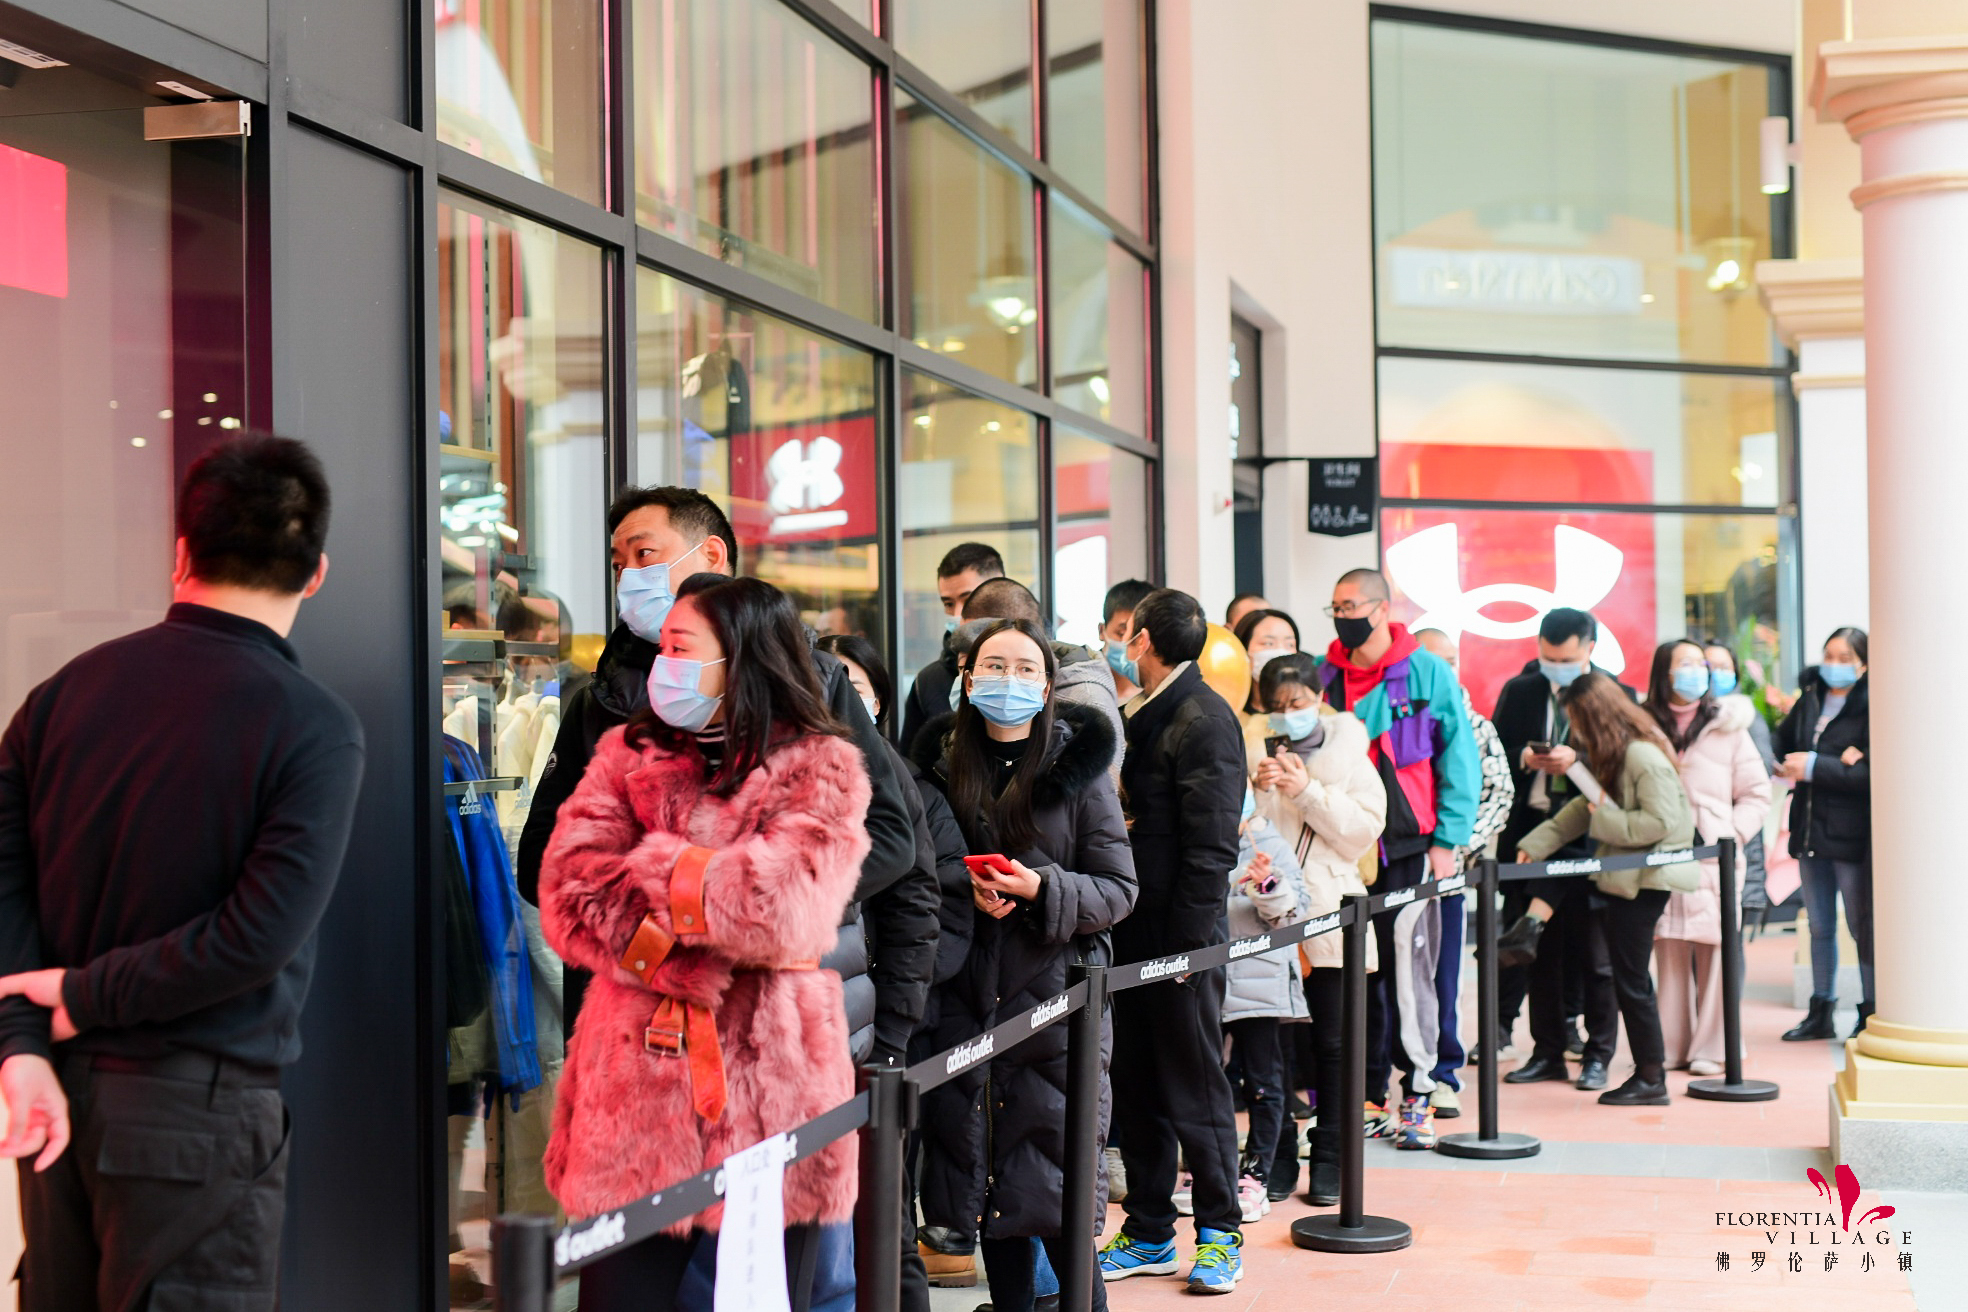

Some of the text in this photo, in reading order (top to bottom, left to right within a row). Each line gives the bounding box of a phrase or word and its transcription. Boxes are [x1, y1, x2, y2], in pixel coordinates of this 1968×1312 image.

[1229, 935, 1271, 959] adidas outlet
[1140, 955, 1190, 981] adidas outlet
[1030, 1001, 1051, 1029] adidas
[1050, 994, 1069, 1019] outlet
[946, 1033, 994, 1074] adidas outlet
[569, 1211, 626, 1262] outlet
